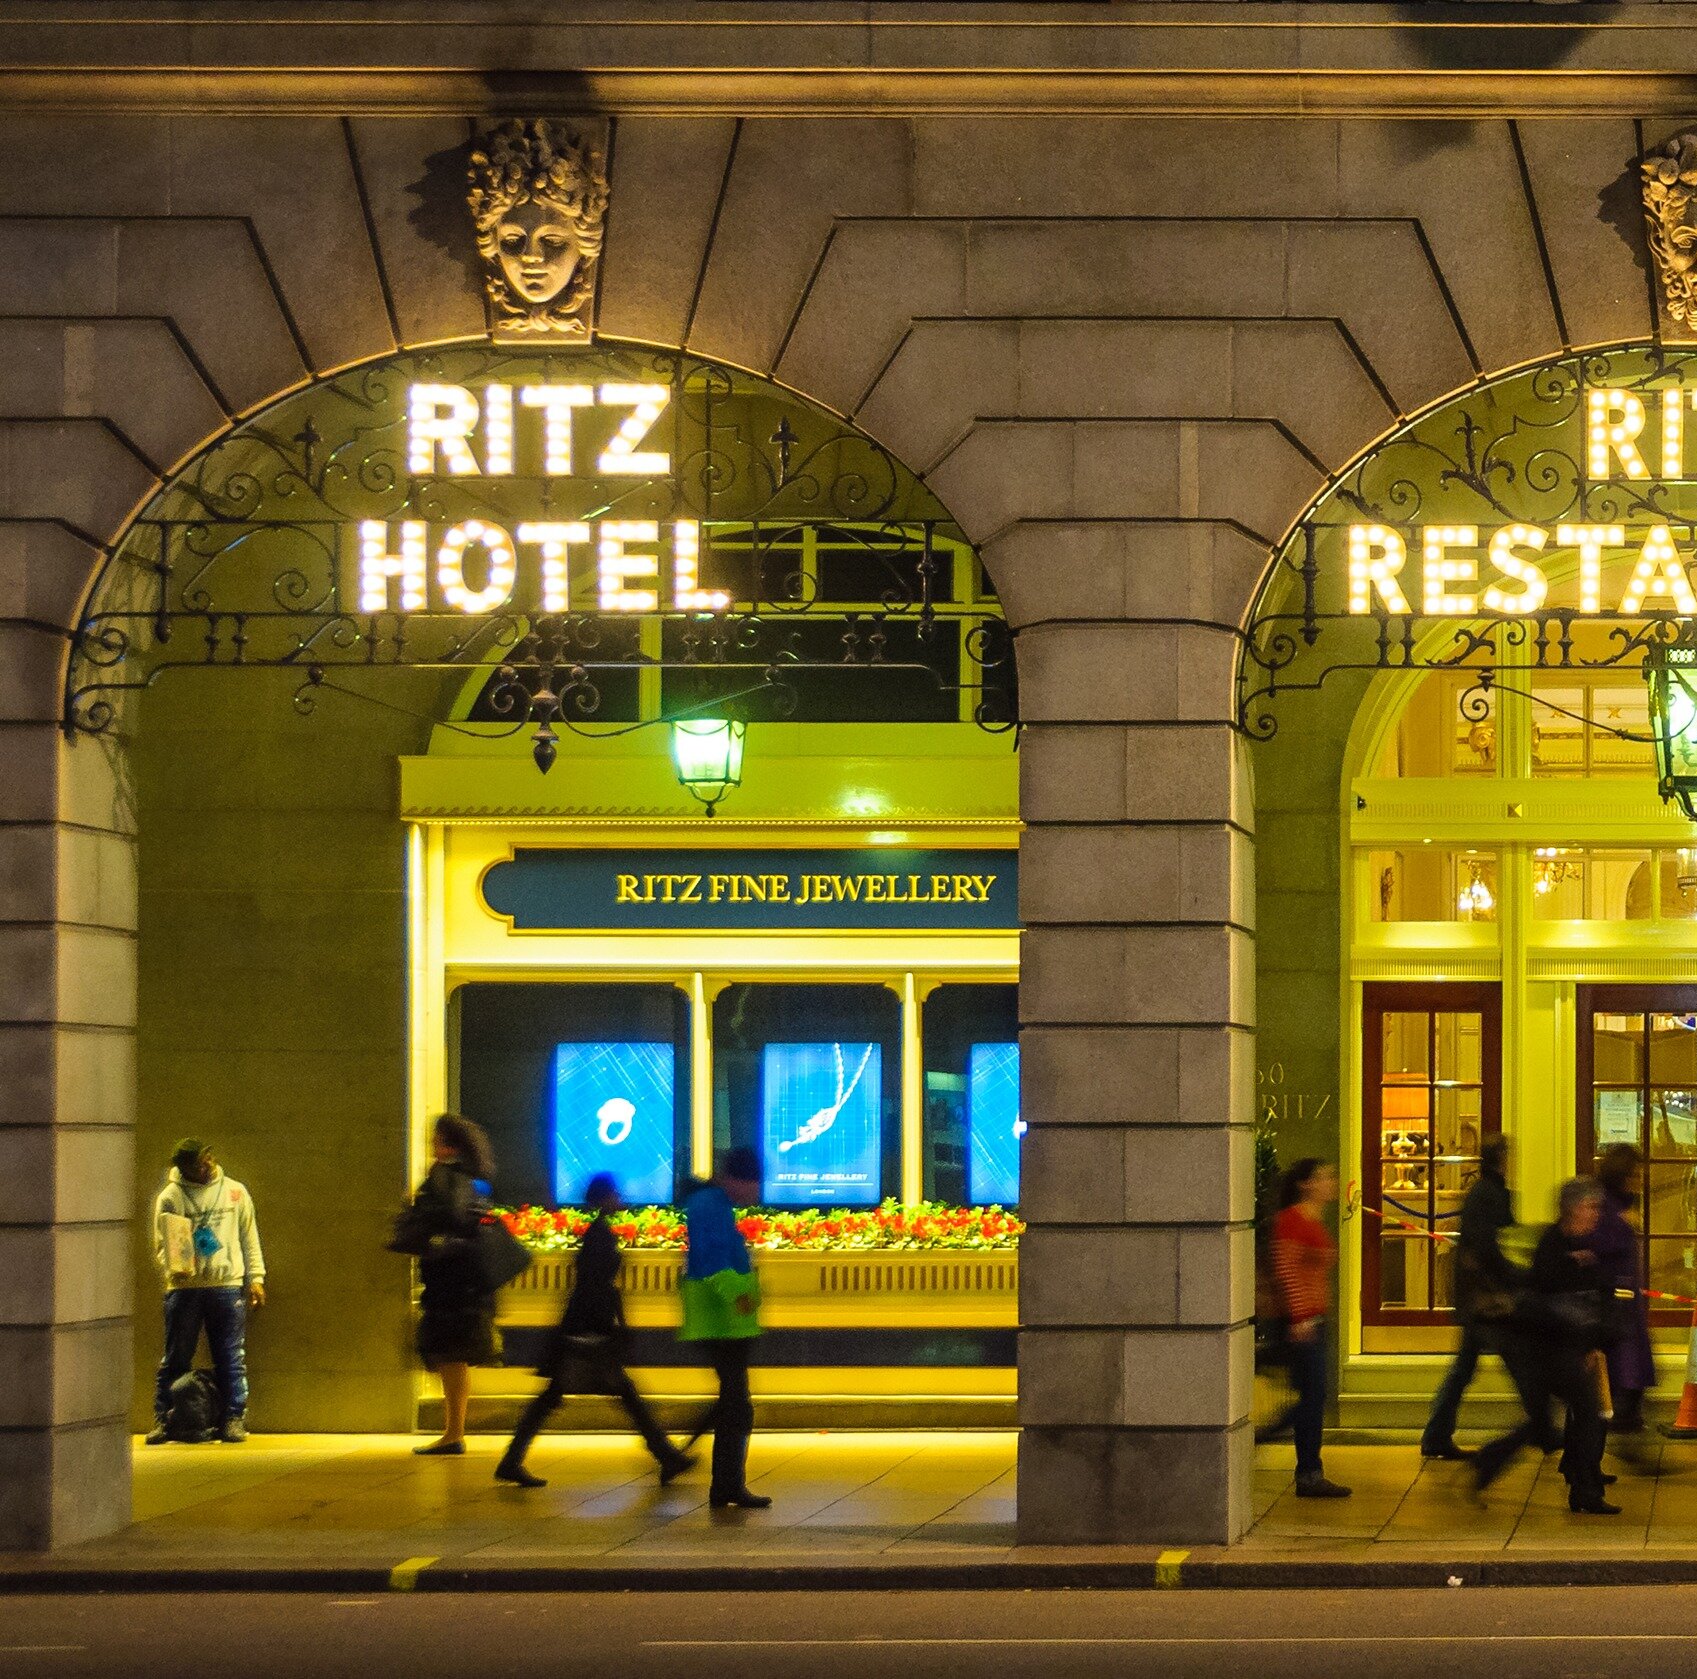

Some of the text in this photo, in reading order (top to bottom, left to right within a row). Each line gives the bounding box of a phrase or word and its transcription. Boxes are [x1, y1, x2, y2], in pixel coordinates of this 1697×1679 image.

[408, 383, 672, 476] RITZ
[359, 519, 731, 613] HOTEL
[616, 874, 997, 904] RITZ FINE JEWELLERY
[1261, 1094, 1331, 1119] RITZ
